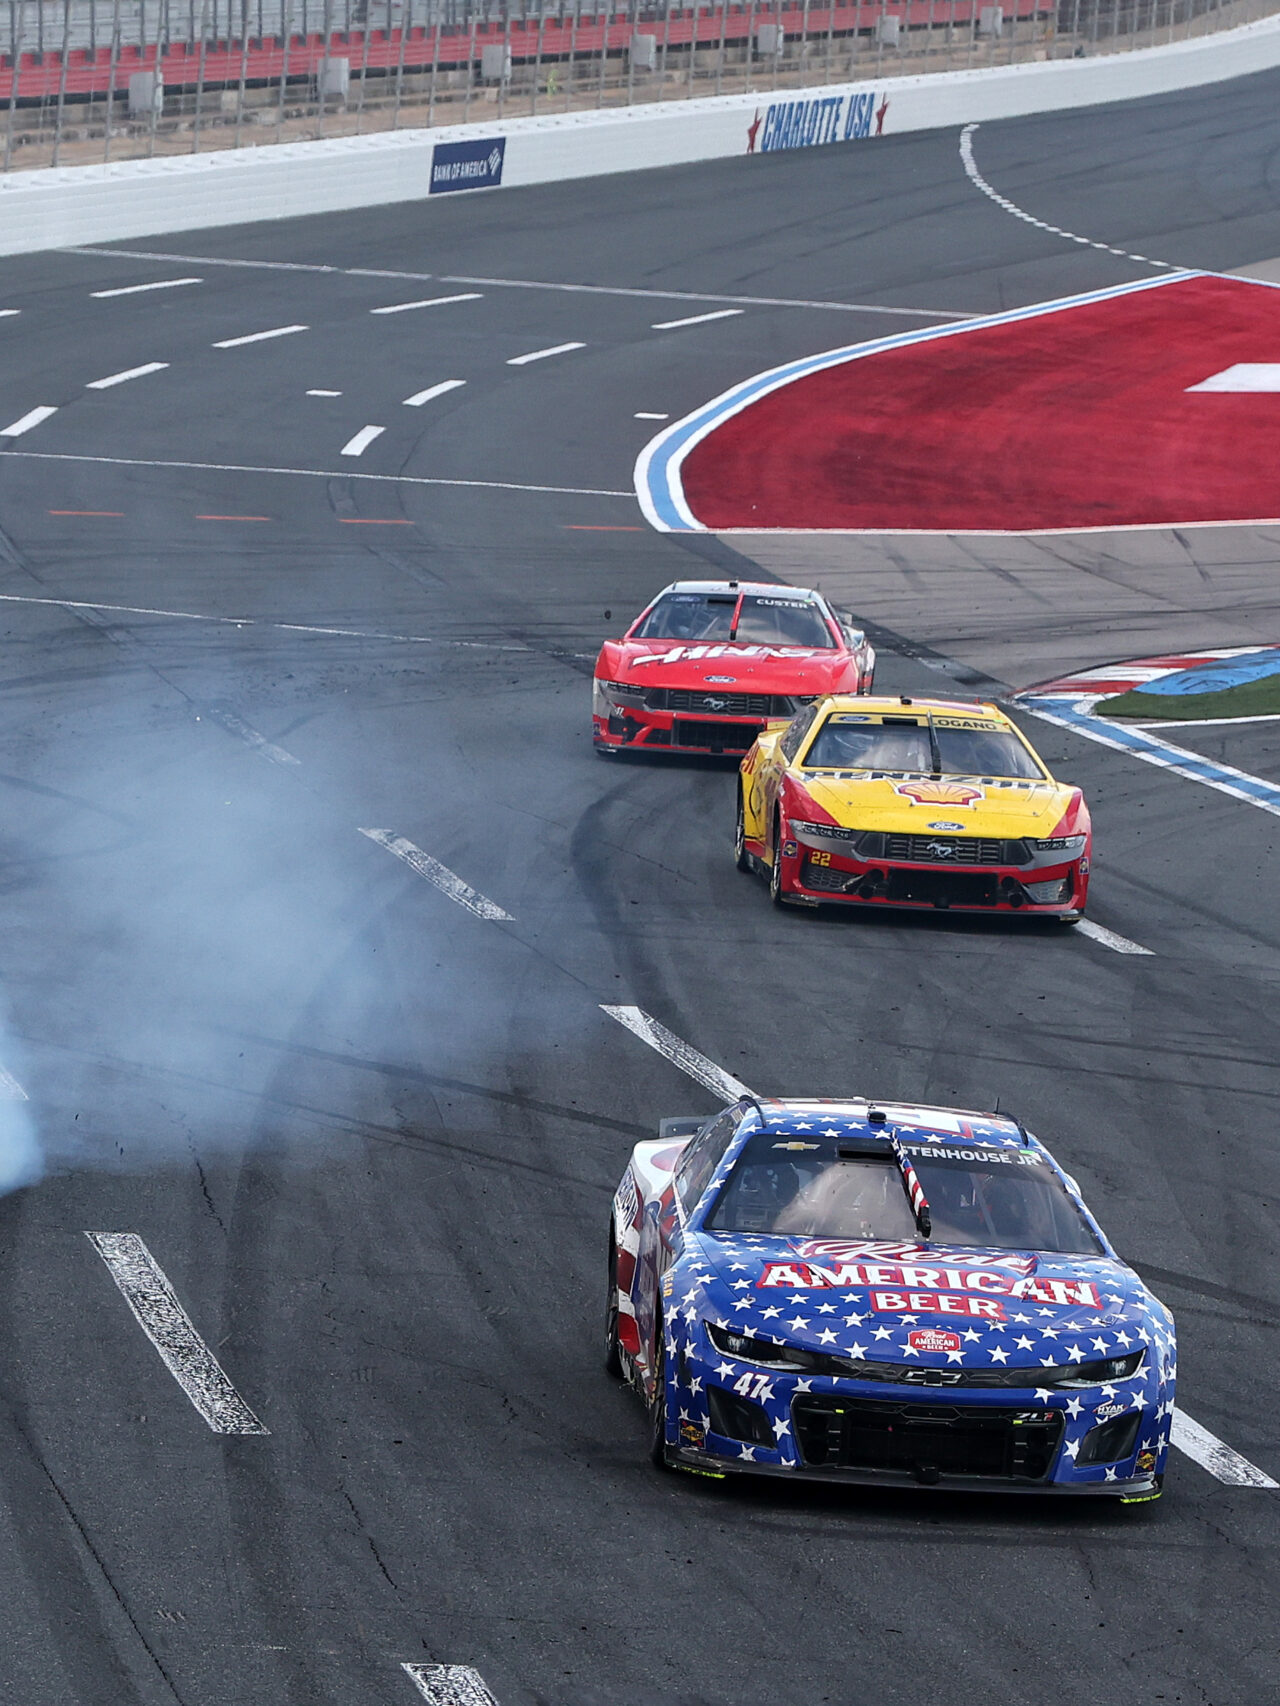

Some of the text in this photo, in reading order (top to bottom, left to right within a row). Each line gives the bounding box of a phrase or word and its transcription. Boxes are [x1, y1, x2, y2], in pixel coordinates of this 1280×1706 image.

[761, 92, 875, 152] CHARLOTTE USA
[433, 160, 488, 182] BANK OF AMERICA
[756, 598, 809, 609] CUSTER
[810, 851, 832, 867] 22
[1017, 1154, 1040, 1166] JR
[790, 1239, 1036, 1275] Real
[762, 1262, 1098, 1307] AMERICAN
[873, 1292, 1002, 1317] BEER
[915, 1338, 955, 1347] AMERICAN
[733, 1371, 770, 1399] 47
[1097, 1403, 1125, 1415] HYAK
